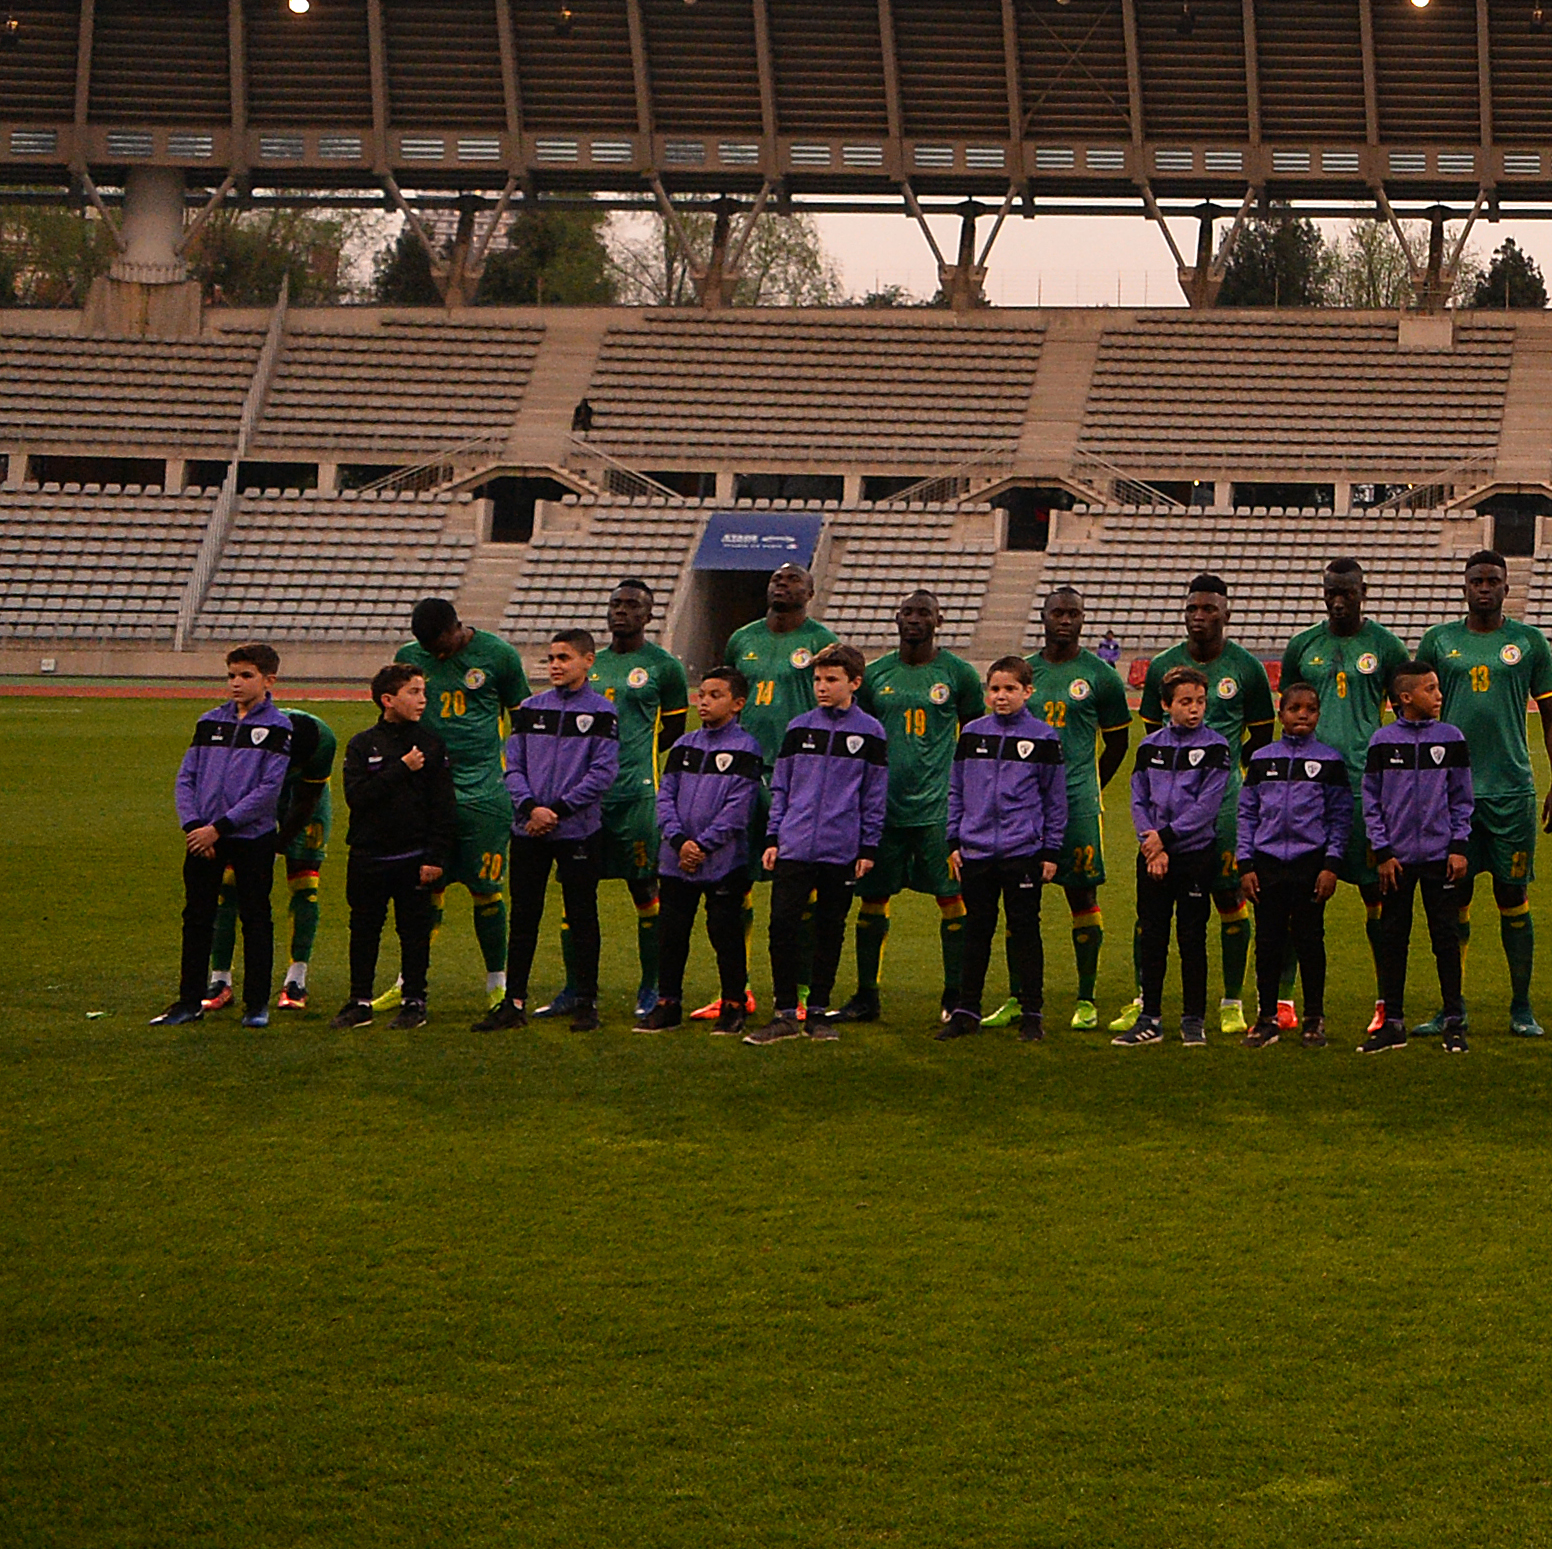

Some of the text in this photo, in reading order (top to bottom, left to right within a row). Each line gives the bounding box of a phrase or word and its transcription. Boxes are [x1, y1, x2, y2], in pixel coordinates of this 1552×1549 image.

[1469, 664, 1490, 692] 13
[440, 690, 467, 718] 20
[755, 680, 774, 706] 14
[905, 707, 927, 737] 19
[1044, 700, 1067, 727] 22
[479, 852, 502, 882] 20
[1073, 844, 1095, 873] 22
